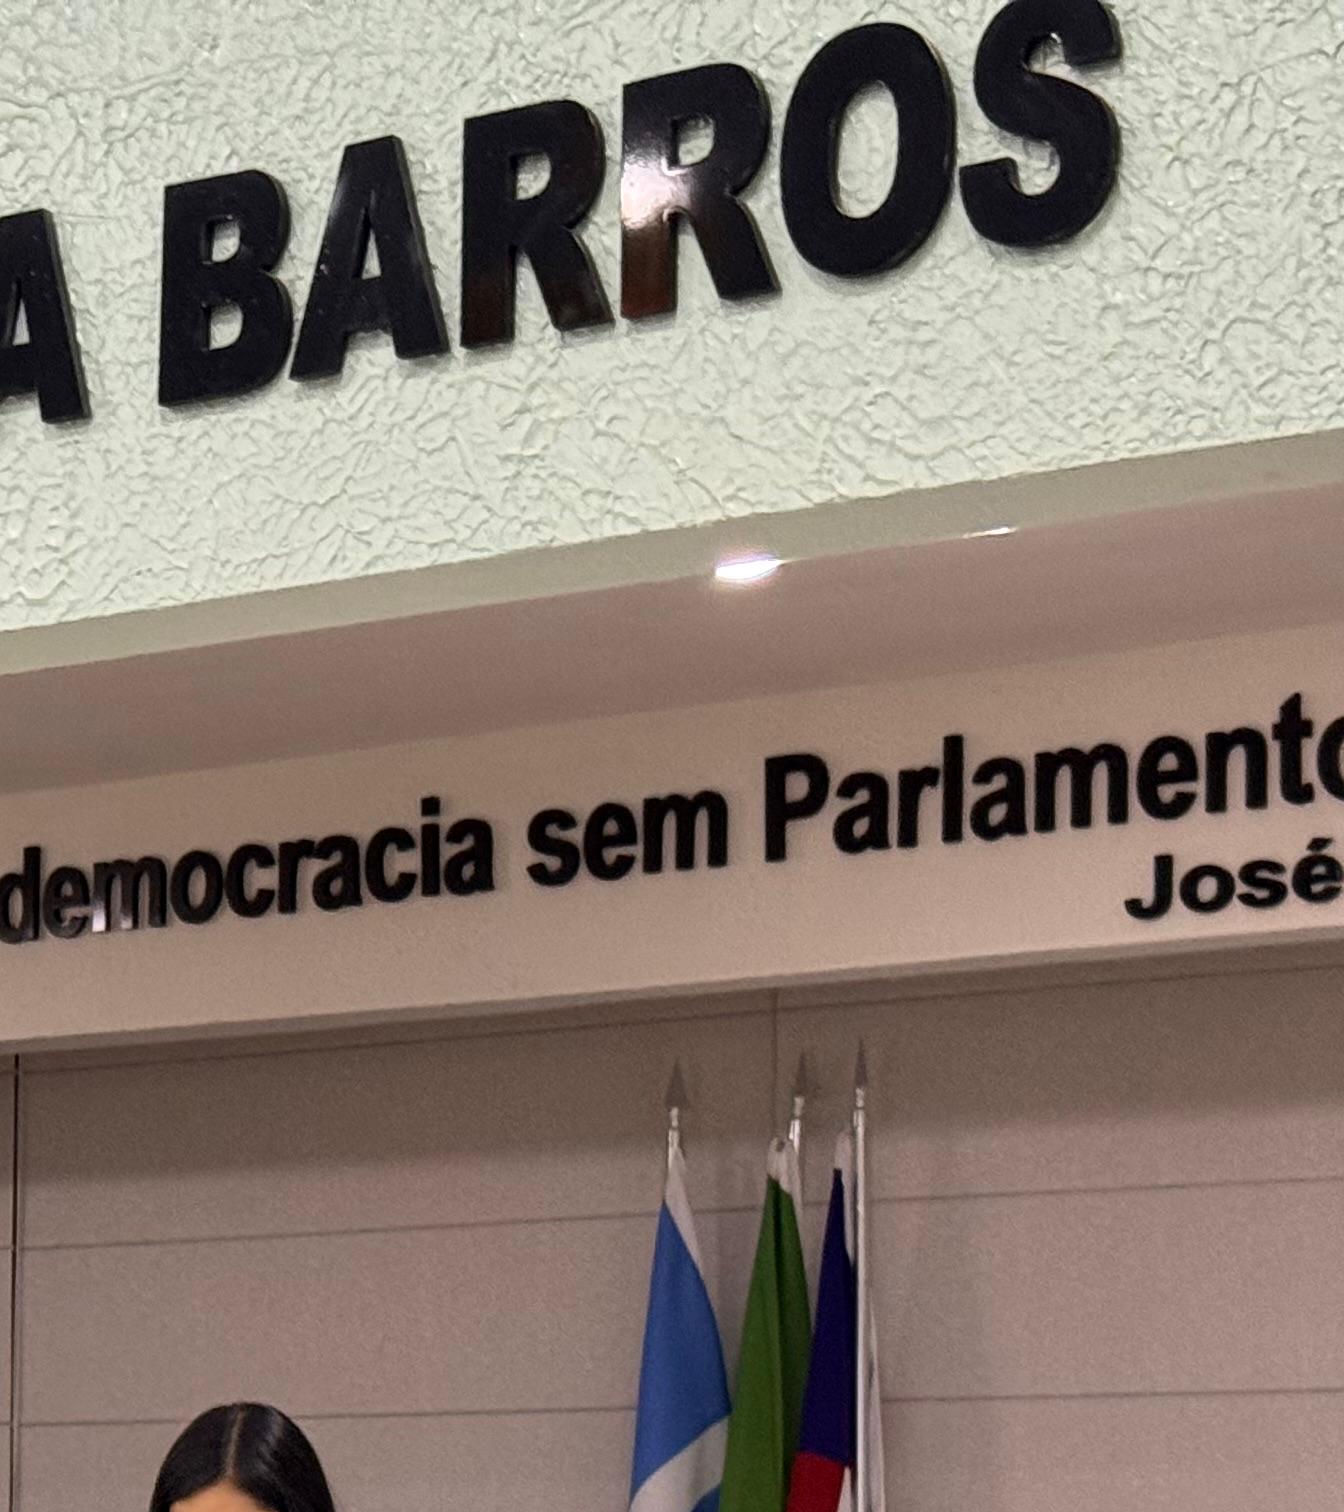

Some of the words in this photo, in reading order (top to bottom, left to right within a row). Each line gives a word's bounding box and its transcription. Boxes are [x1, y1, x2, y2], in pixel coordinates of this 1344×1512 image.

[158, 0, 1123, 408] BARROS
[526, 789, 729, 888] sem
[1124, 836, 1344, 921] José
